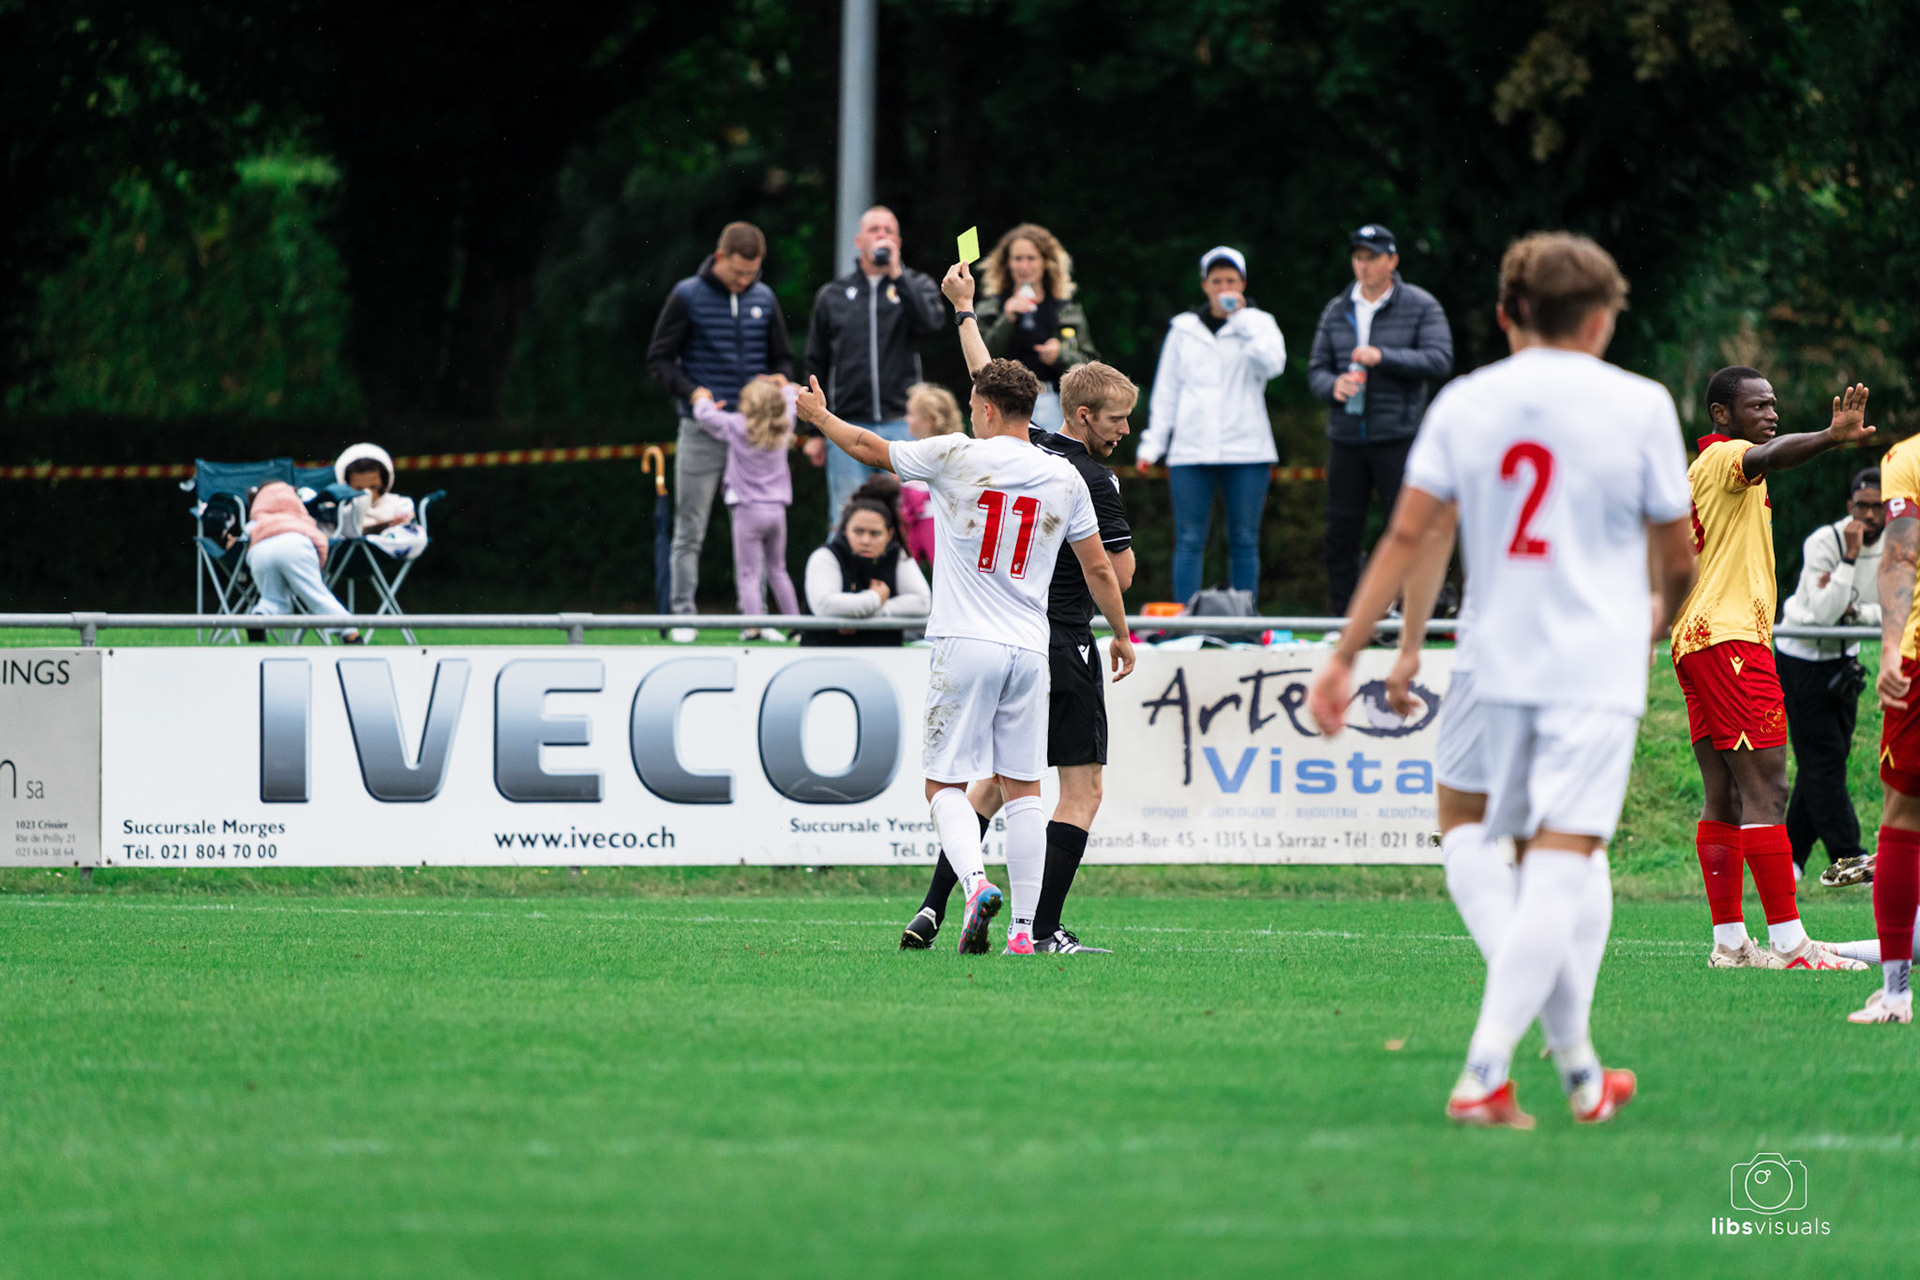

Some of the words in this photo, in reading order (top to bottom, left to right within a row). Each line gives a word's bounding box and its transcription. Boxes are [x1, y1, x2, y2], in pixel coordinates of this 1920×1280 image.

[1501, 442, 1556, 560] 2
[977, 489, 1042, 580] 11
[2, 659, 70, 686] INGS
[259, 656, 904, 805] IVECO
[1201, 746, 1435, 795] Vista
[26, 780, 45, 799] sa
[123, 819, 216, 835] Succursale
[222, 819, 286, 838] Morges
[494, 825, 676, 849] www.iveco.ch
[790, 817, 881, 833] Succursale
[1088, 830, 1169, 848] Grand-Rue
[1176, 831, 1196, 848] 45
[1215, 831, 1248, 848] 1315
[1253, 831, 1272, 848] La
[1277, 831, 1327, 848] Sarraz
[1380, 831, 1408, 848] 021
[123, 844, 155, 860] Tél.
[160, 844, 188, 860] 021
[195, 844, 227, 860] 804
[232, 844, 252, 860] 70
[257, 844, 278, 860] 00
